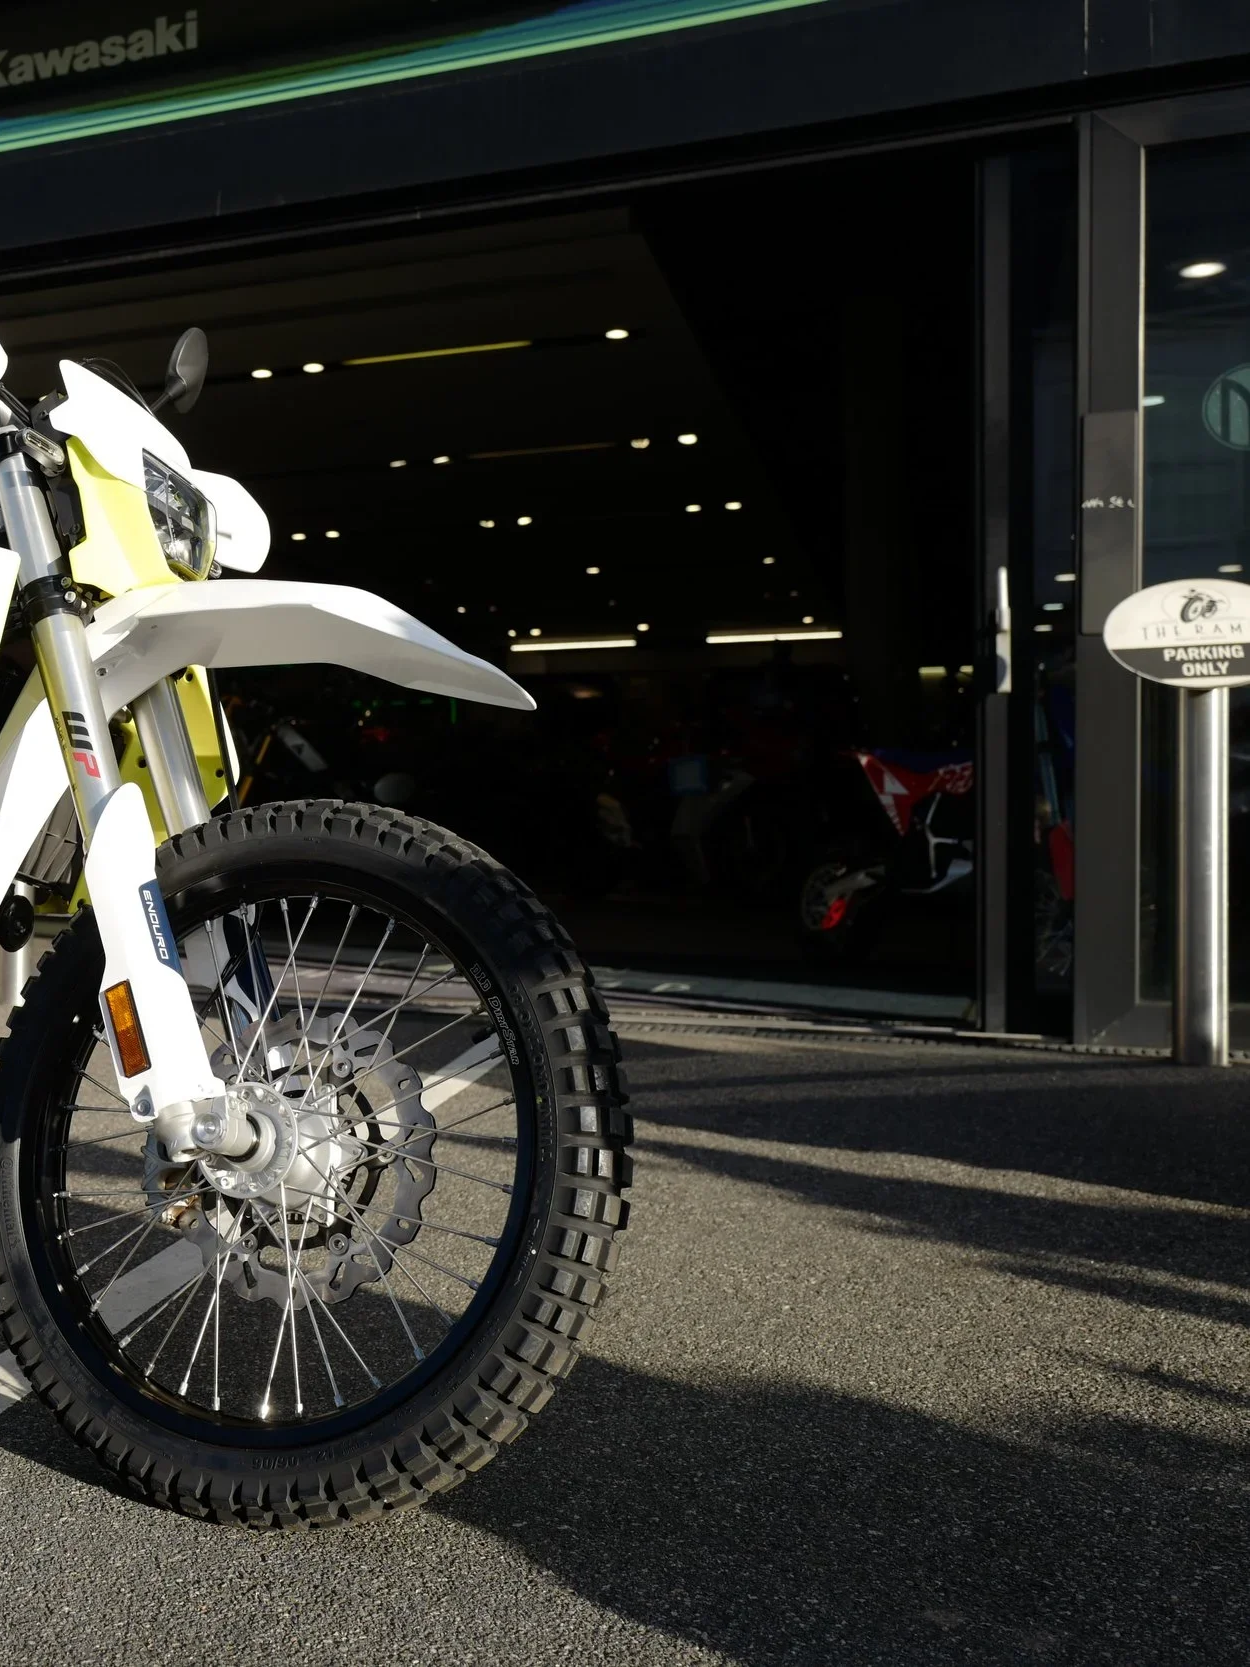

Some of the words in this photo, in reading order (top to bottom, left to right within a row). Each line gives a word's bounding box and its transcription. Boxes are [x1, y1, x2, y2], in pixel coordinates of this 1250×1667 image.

[1141, 626, 1182, 641] THE
[1195, 623, 1243, 636] RAM
[1163, 645, 1245, 662] PARKING
[1181, 661, 1230, 677] ONLY
[142, 889, 170, 960] ENDURO
